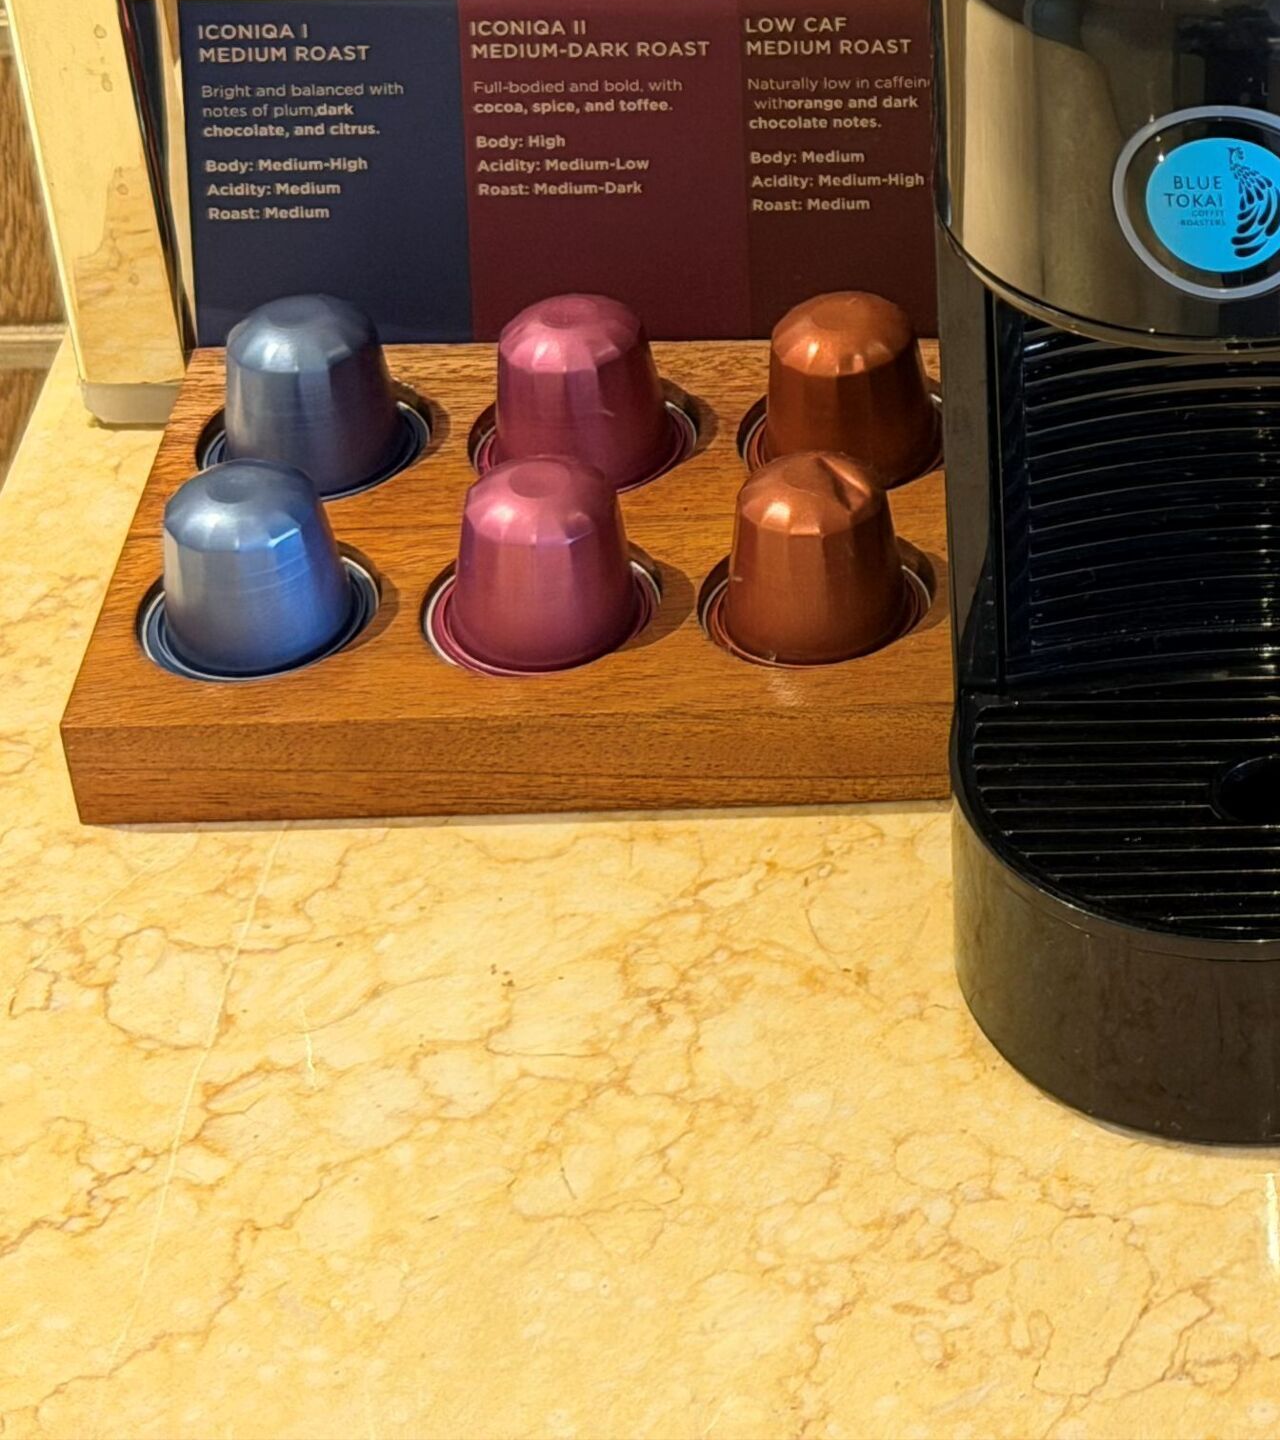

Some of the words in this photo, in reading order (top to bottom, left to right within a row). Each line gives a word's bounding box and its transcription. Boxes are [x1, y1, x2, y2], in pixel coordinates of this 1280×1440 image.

[198, 24, 295, 40] ICONIQA
[301, 24, 308, 38] I
[470, 20, 565, 36] ICONIQA
[574, 20, 587, 35] II
[746, 18, 795, 33] LOW
[804, 17, 847, 32] CAF
[200, 47, 287, 63] MEDIUM
[295, 45, 370, 60] ROAST
[471, 42, 629, 59] MEDIUM-DARK
[637, 42, 710, 57] ROAST
[747, 40, 831, 55] MEDIUM
[840, 39, 911, 54] ROAST
[201, 85, 251, 100] Bright
[256, 85, 286, 97] and
[291, 83, 364, 96] balanced
[370, 82, 404, 95] with
[474, 81, 564, 93] Full-bodied
[570, 80, 599, 92] and
[649, 79, 682, 92] with
[748, 77, 818, 92] Naturally
[824, 77, 850, 89] low
[856, 78, 869, 88] in
[875, 76, 930, 88] caffein
[474, 102, 528, 115] cocoa,
[533, 100, 580, 115] spice,
[585, 100, 614, 111] and
[619, 99, 673, 111] toffee.
[848, 96, 877, 108] and
[883, 96, 918, 108] dark
[202, 106, 247, 117] notes
[252, 104, 268, 117] of
[203, 124, 289, 138] chocolate,
[294, 123, 325, 136] and
[330, 123, 380, 135] citrus.
[749, 117, 827, 129] chocolate
[833, 117, 882, 128] notes.
[476, 136, 523, 149] Body:
[528, 135, 565, 149] High
[205, 159, 254, 174] Body:
[258, 157, 368, 172] Medium-High
[751, 151, 796, 165] Body:
[802, 151, 864, 163] Medium
[478, 160, 541, 173] Acidity:
[545, 159, 649, 171] Medium-Low
[752, 175, 813, 189] Acidity:
[818, 173, 924, 188] Medium-High
[1174, 176, 1222, 190] BLUE
[207, 183, 271, 198] Acidity:
[275, 182, 341, 195] Medium
[478, 183, 529, 196] Roast:
[534, 182, 642, 194] Medium-Dark
[752, 199, 802, 211] Roast:
[807, 198, 870, 210] Medium
[1164, 194, 1223, 208] TOKAI
[208, 207, 260, 220] Roast:
[264, 206, 330, 218] Medium
